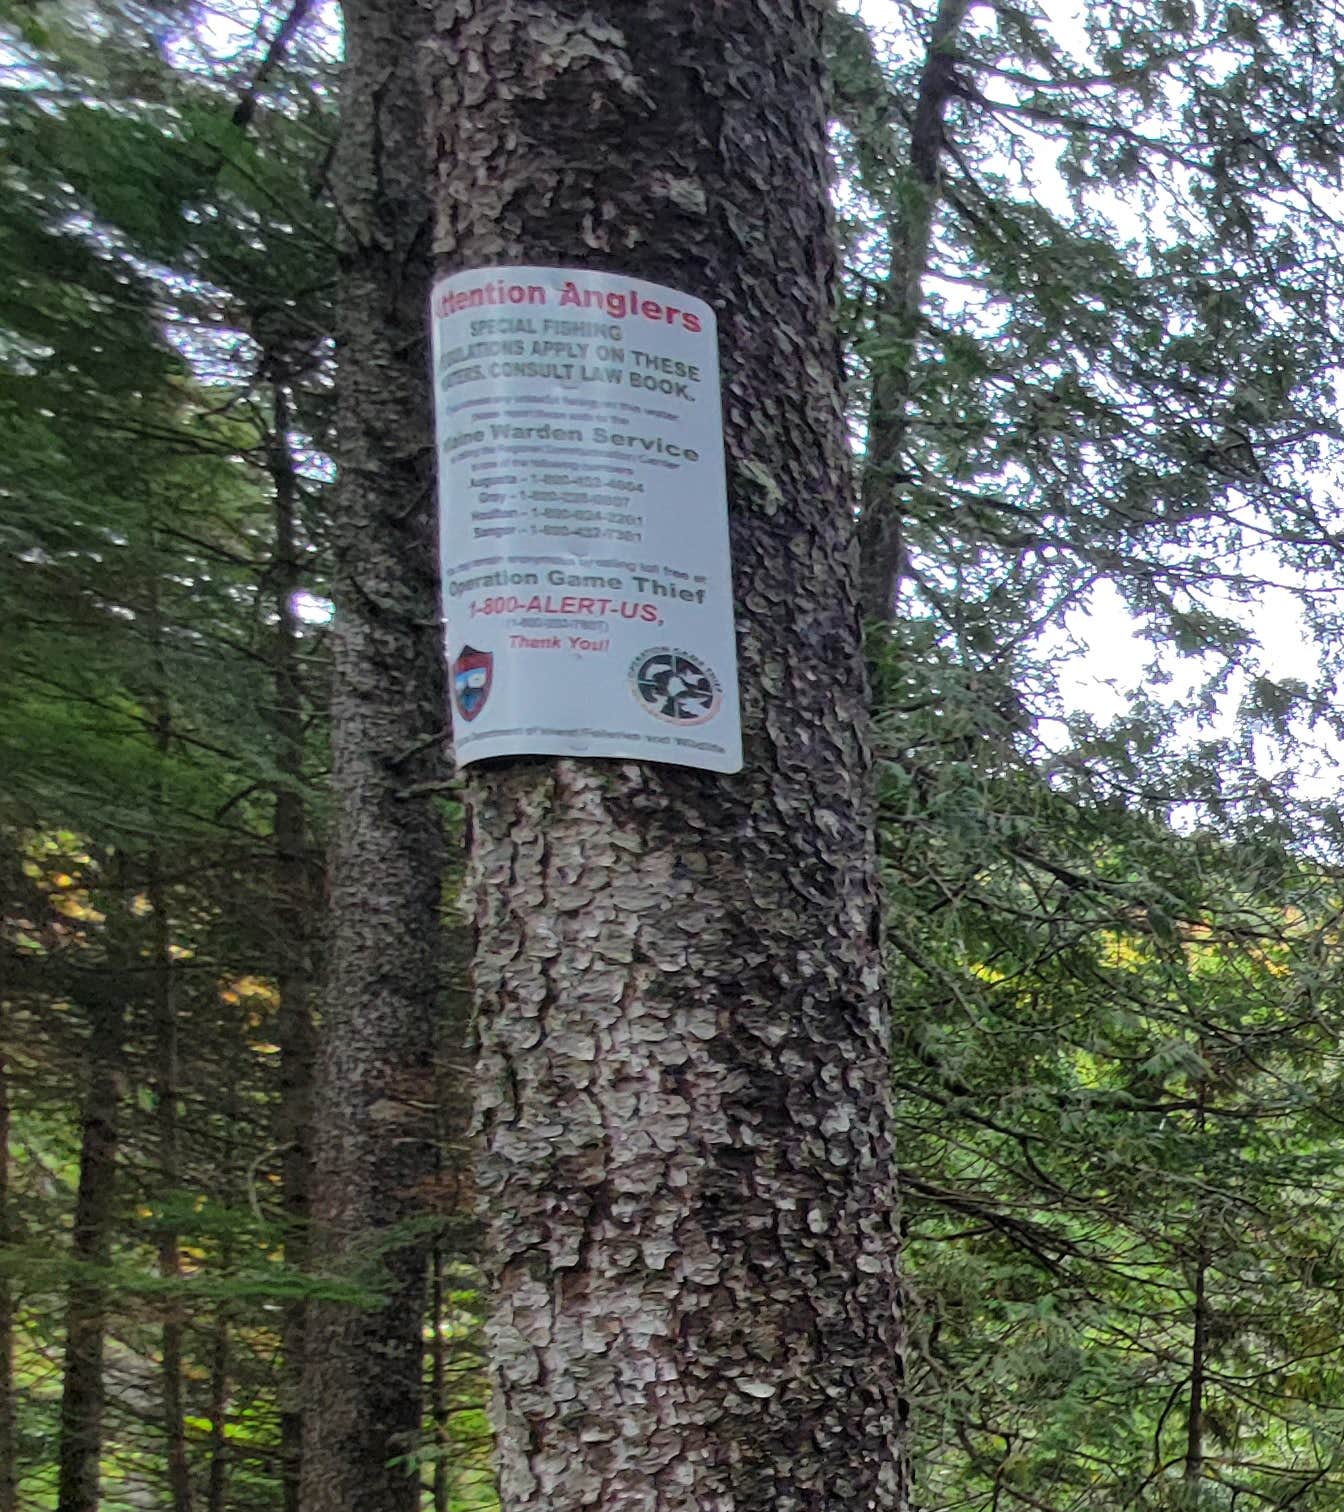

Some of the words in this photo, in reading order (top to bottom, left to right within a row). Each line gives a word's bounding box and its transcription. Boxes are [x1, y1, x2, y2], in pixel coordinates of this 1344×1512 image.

[558, 281, 702, 333] Anglers
[470, 319, 537, 337] SPECIAL
[543, 319, 623, 341] FISHING
[490, 361, 574, 380] CONSULT
[580, 364, 623, 384] LAW
[531, 340, 588, 360] APPLY
[595, 344, 625, 363] ON
[630, 350, 701, 382] THESE
[489, 423, 583, 442] Warden
[592, 426, 700, 462] Service
[449, 569, 538, 597] Operation
[547, 570, 622, 590] Game
[632, 576, 706, 604] Thief
[509, 635, 561, 649] Thank
